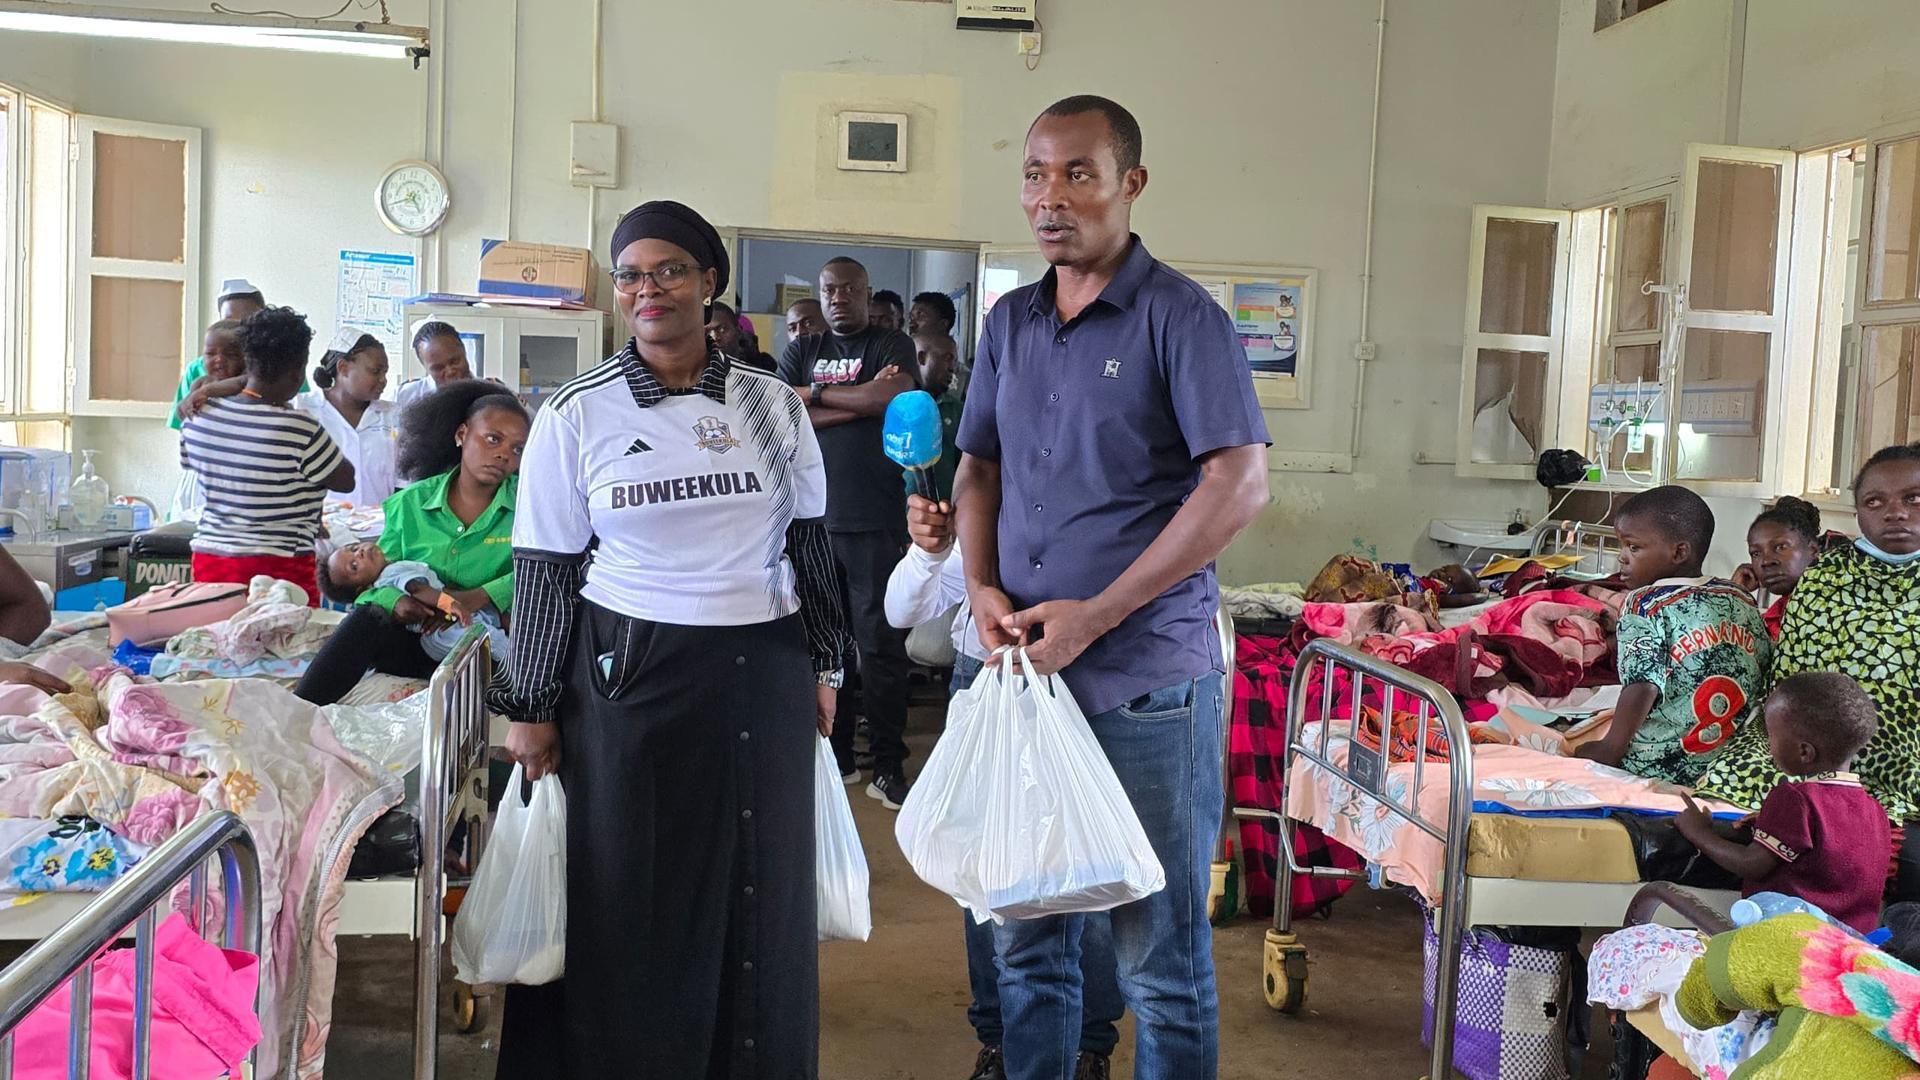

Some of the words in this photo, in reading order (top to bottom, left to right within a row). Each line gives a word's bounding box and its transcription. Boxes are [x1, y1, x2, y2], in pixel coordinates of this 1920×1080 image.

[813, 358, 862, 383] EASY
[611, 471, 763, 510] BUWEEKULA
[1679, 674, 1748, 755] 8
